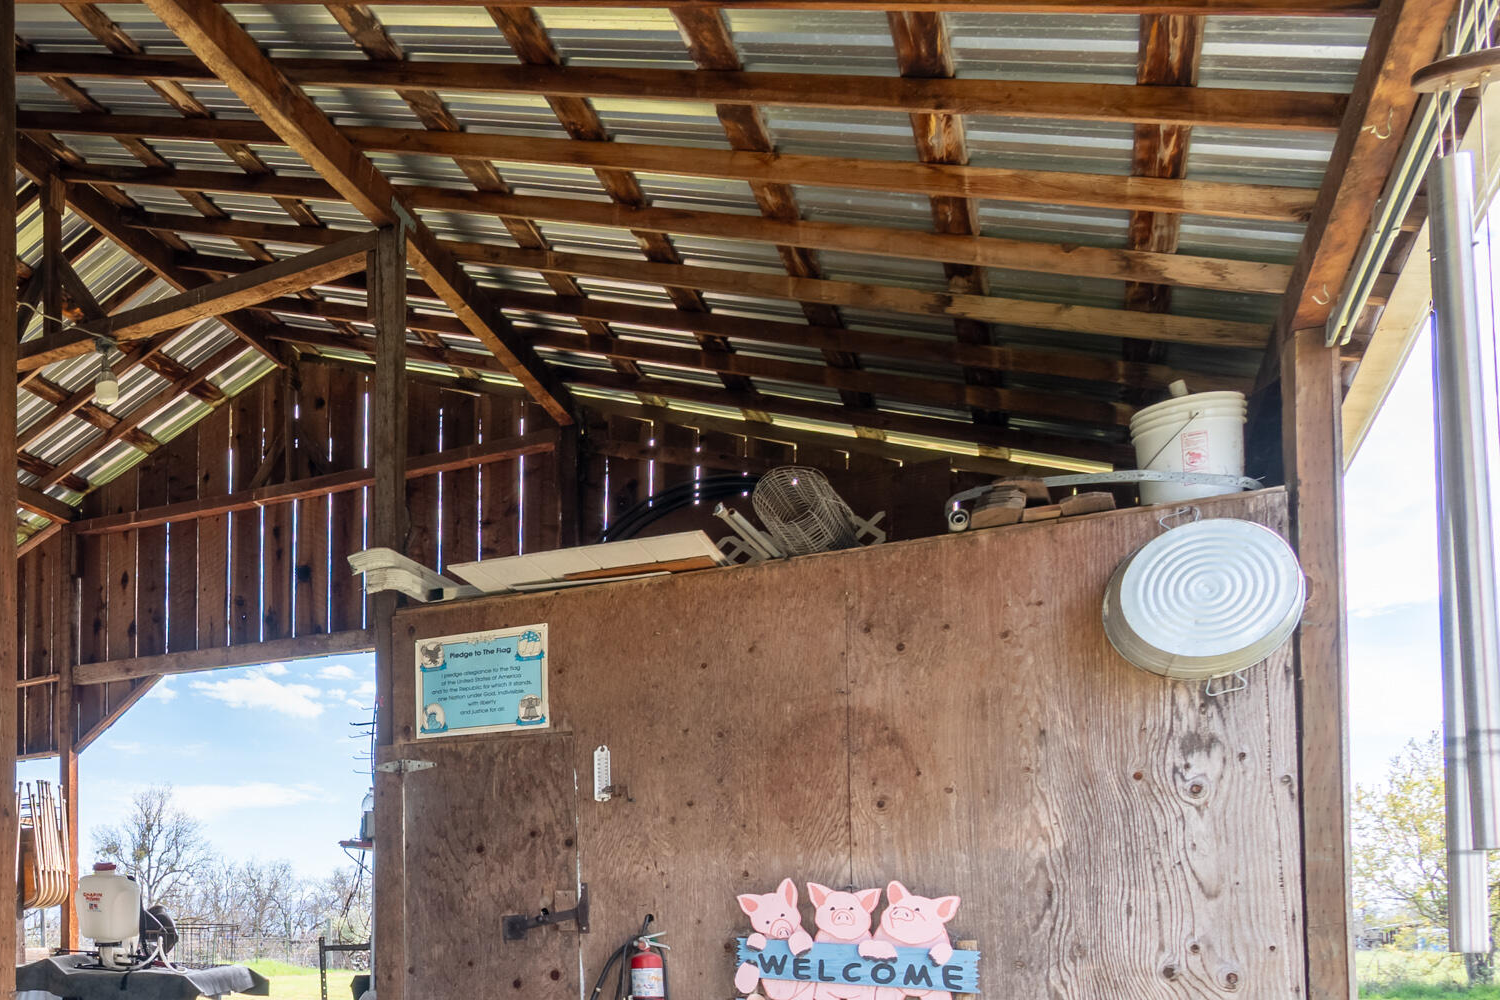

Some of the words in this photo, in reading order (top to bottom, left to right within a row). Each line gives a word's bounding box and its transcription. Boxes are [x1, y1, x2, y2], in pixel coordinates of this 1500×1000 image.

[449, 650, 473, 659] Pledge
[482, 648, 495, 656] The
[495, 647, 512, 655] Flag
[463, 668, 492, 677] allegiance
[479, 698, 497, 706] liberty
[758, 953, 964, 991] WELCOME
